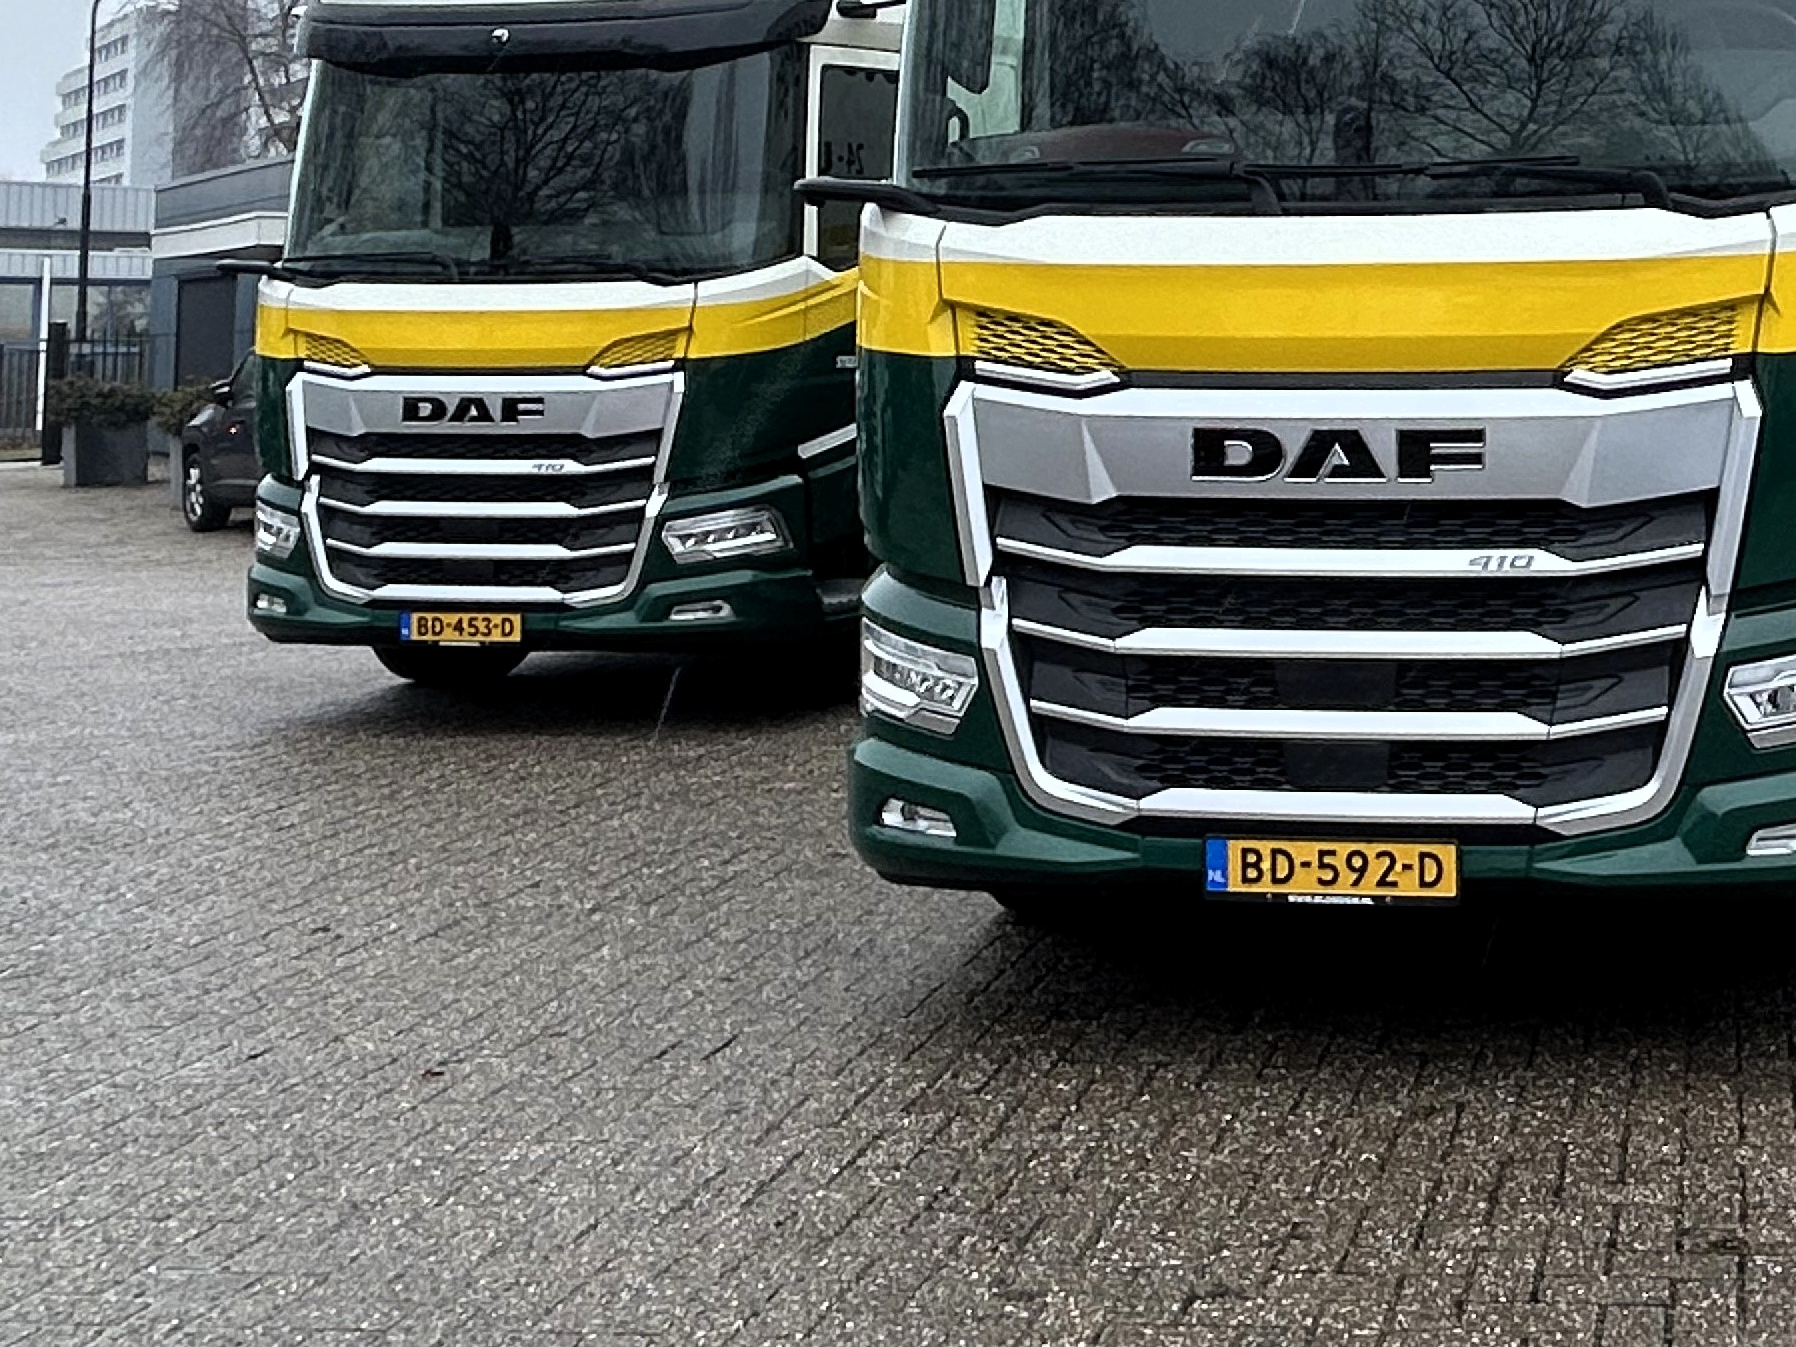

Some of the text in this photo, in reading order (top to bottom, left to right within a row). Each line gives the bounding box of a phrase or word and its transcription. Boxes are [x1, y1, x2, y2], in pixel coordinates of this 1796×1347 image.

[402, 396, 545, 426] DAF
[1191, 427, 1486, 482] DAF
[1469, 555, 1535, 573] 410
[417, 616, 515, 637] BD-453-D
[1240, 847, 1443, 888] BD-592-D
